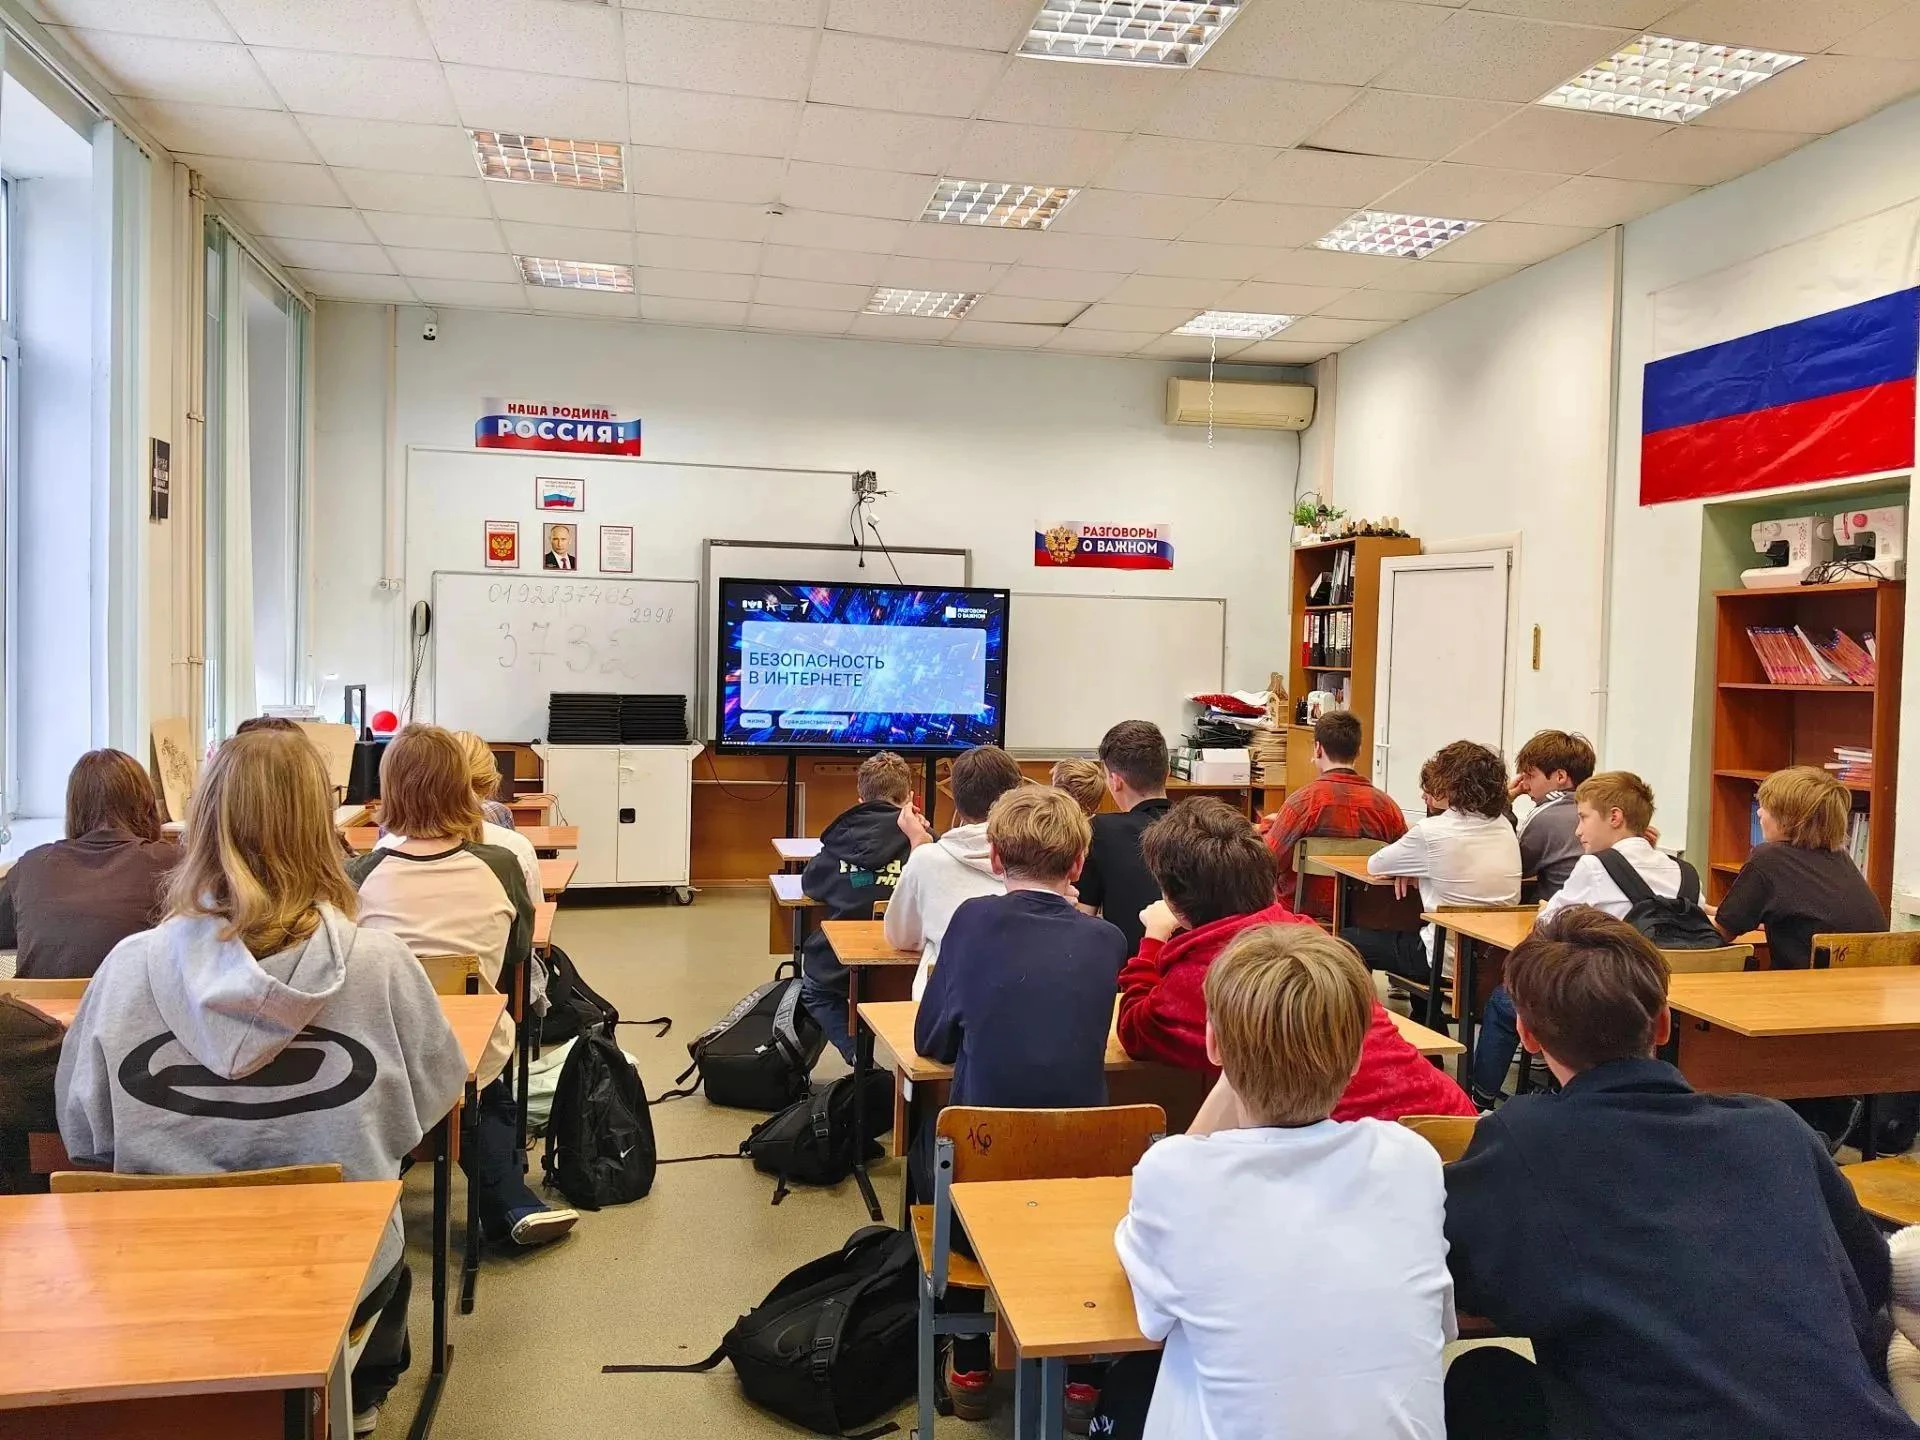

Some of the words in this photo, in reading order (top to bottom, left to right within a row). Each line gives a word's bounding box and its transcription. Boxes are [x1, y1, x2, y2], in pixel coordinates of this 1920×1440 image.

[507, 403, 548, 416] НАША
[497, 418, 625, 444] РОССИЯ!
[1083, 526, 1157, 538] РАЗГОВОРЫ
[1082, 540, 1093, 552] О
[1097, 541, 1157, 554] ВАЖНОМ
[749, 652, 885, 670] БЕЗОПАСНОСТЬ
[749, 671, 760, 685] В
[765, 672, 863, 687] ИНТЕРНЕТЕ
[1833, 946, 1849, 962] 16
